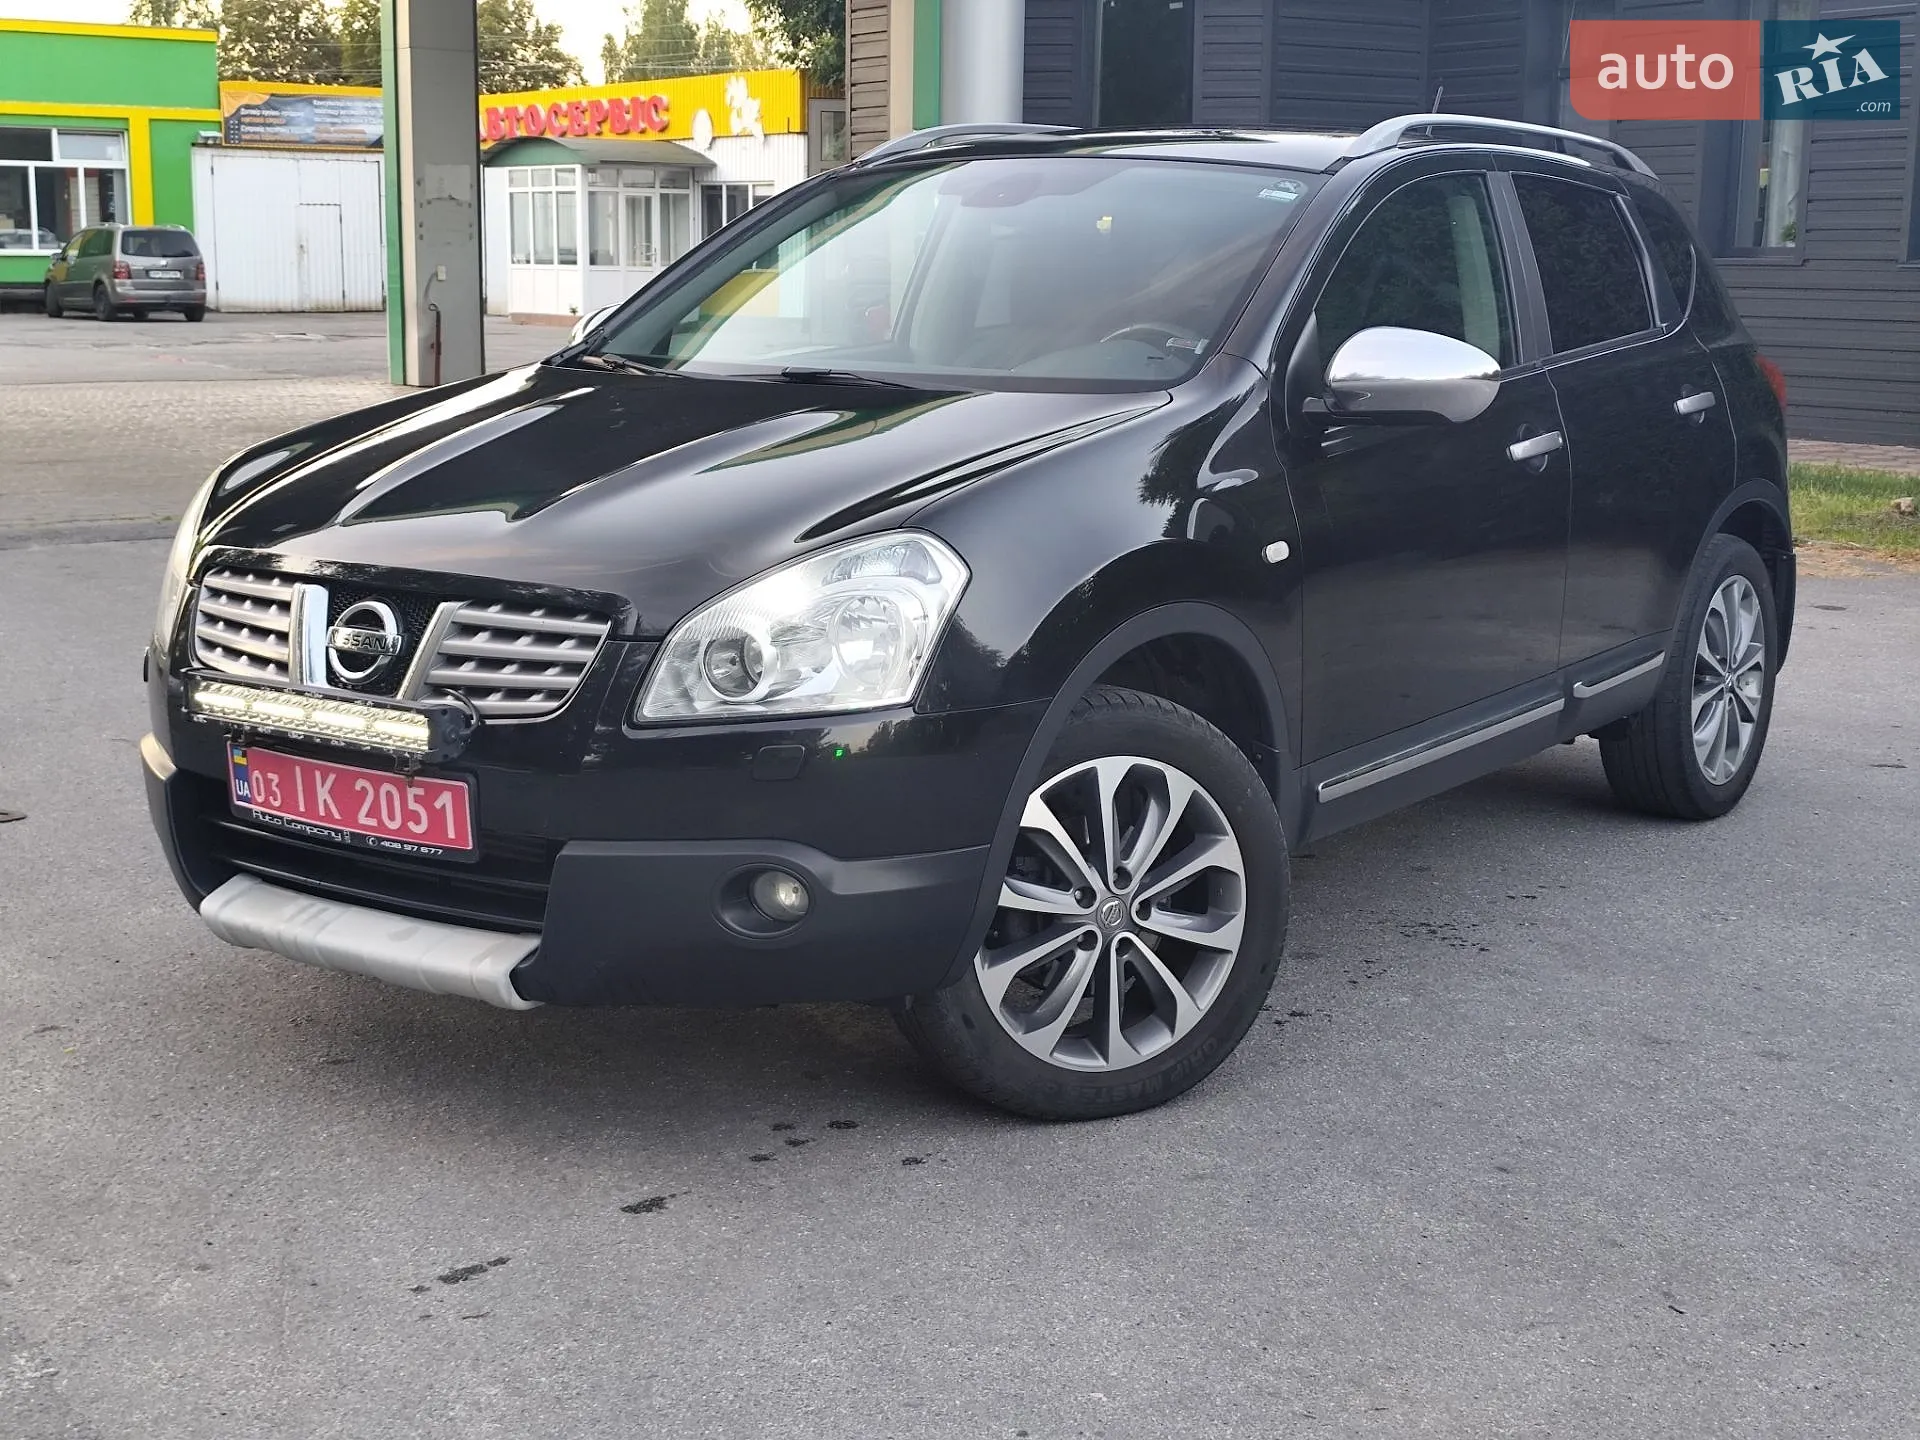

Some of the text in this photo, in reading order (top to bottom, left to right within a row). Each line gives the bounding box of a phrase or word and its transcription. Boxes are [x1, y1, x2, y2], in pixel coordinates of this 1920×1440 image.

[480, 94, 669, 141] ВТОСЕРВІС
[331, 627, 388, 650] NSSAN
[235, 779, 251, 798] UA
[251, 769, 282, 807] 03
[354, 778, 456, 839] 2051
[252, 808, 282, 825] Auto
